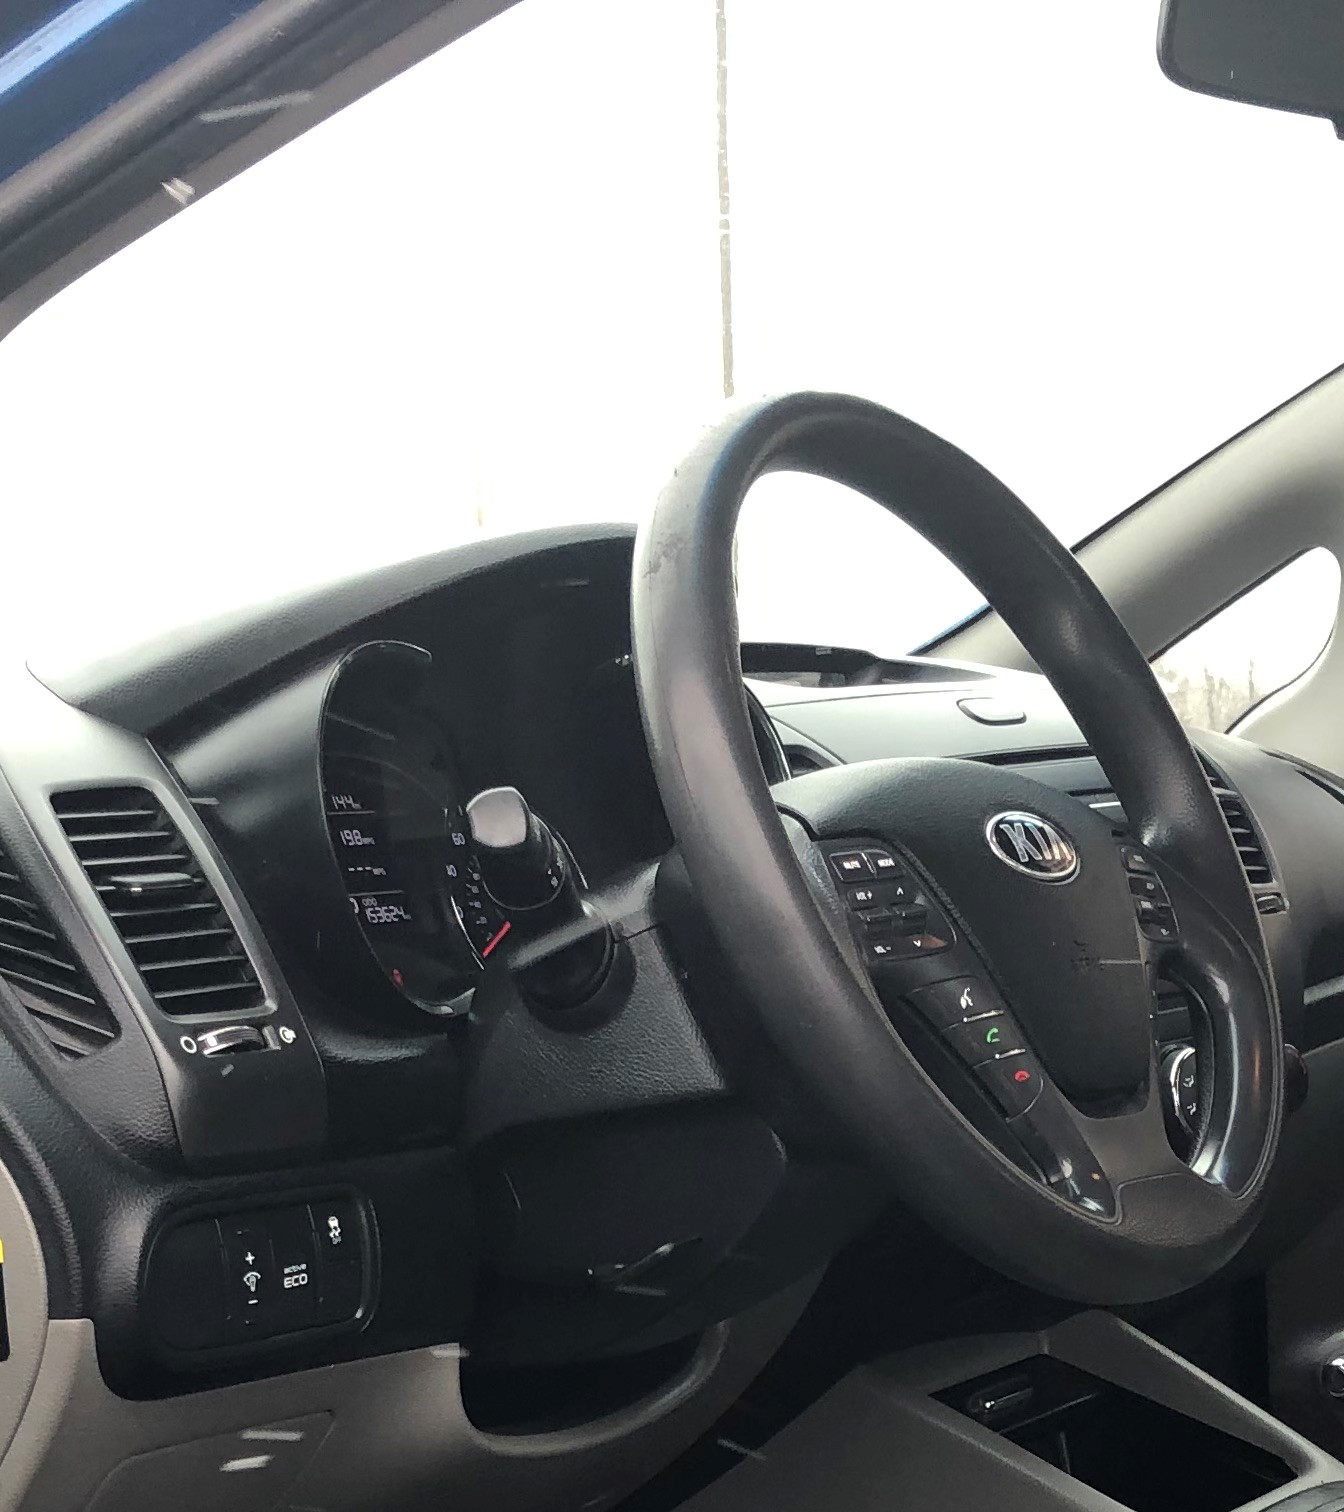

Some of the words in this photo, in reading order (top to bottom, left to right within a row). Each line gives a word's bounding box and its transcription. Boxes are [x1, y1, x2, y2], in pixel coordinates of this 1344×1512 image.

[999, 823, 1072, 862] KIA
[283, 1263, 307, 1274] active
[283, 1273, 308, 1288] ECO
